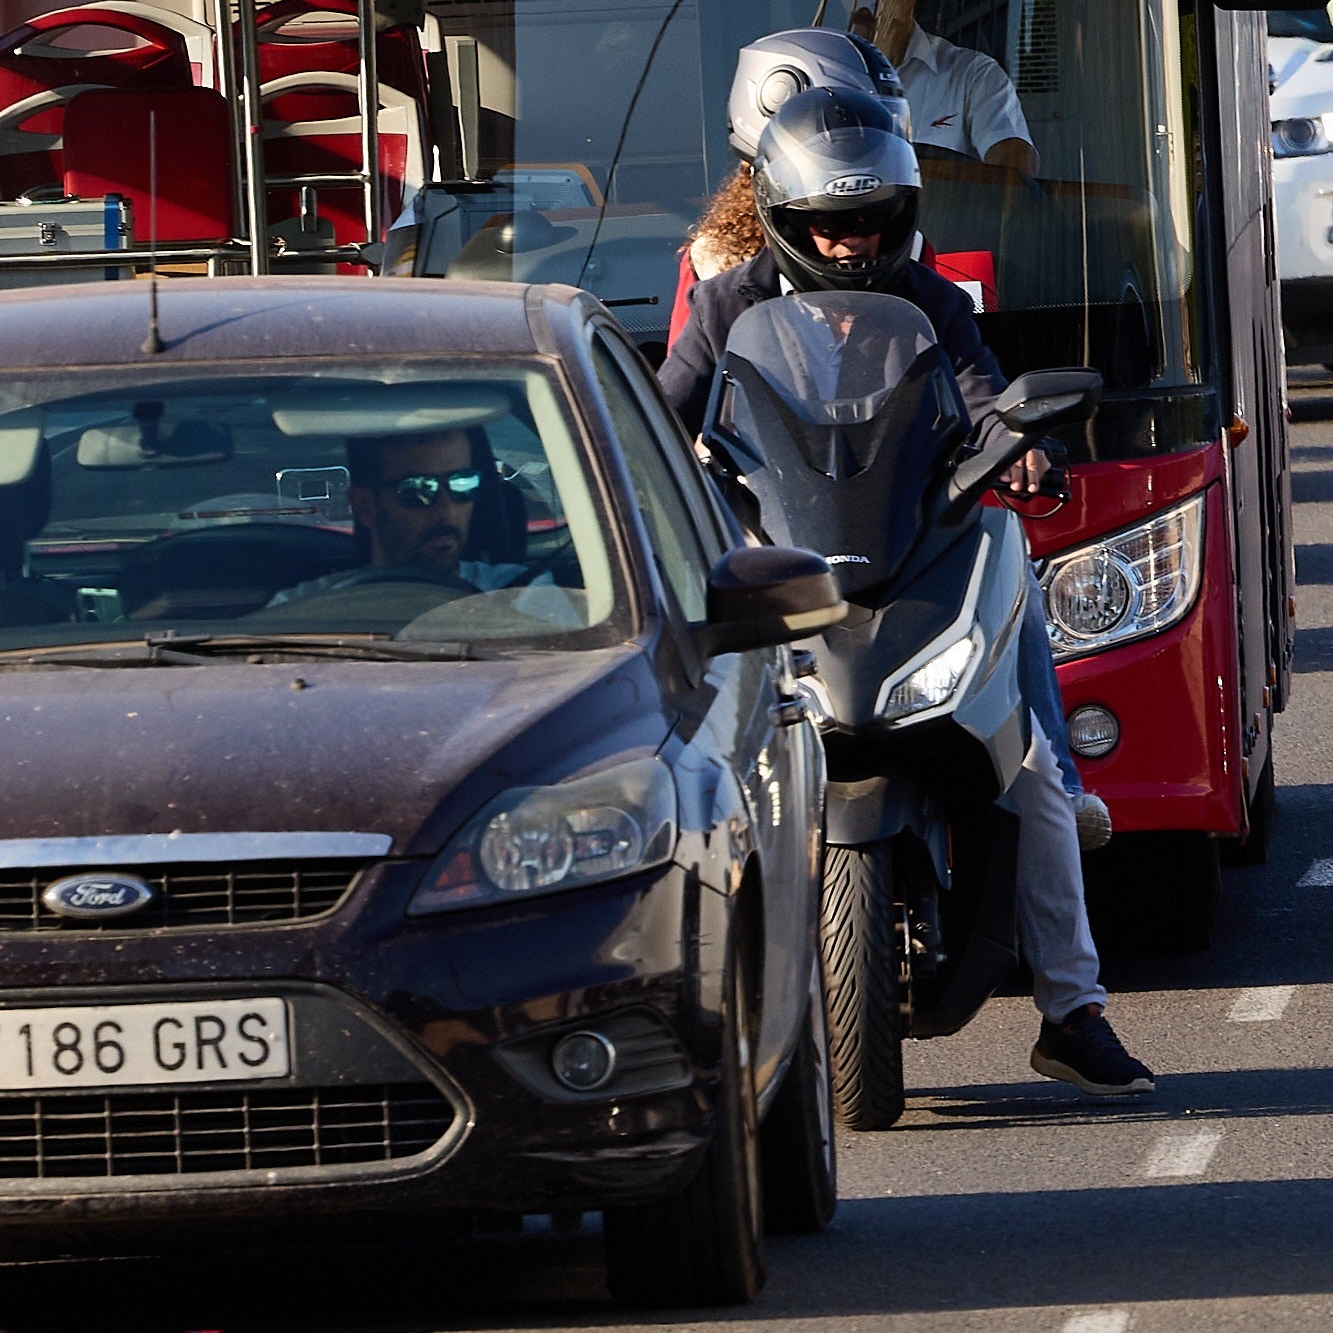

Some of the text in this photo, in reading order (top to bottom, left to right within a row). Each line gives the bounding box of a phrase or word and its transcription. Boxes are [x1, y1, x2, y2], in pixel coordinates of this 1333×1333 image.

[831, 177, 876, 194] HJC
[70, 883, 127, 906] Ford
[153, 1012, 271, 1071] GRS
